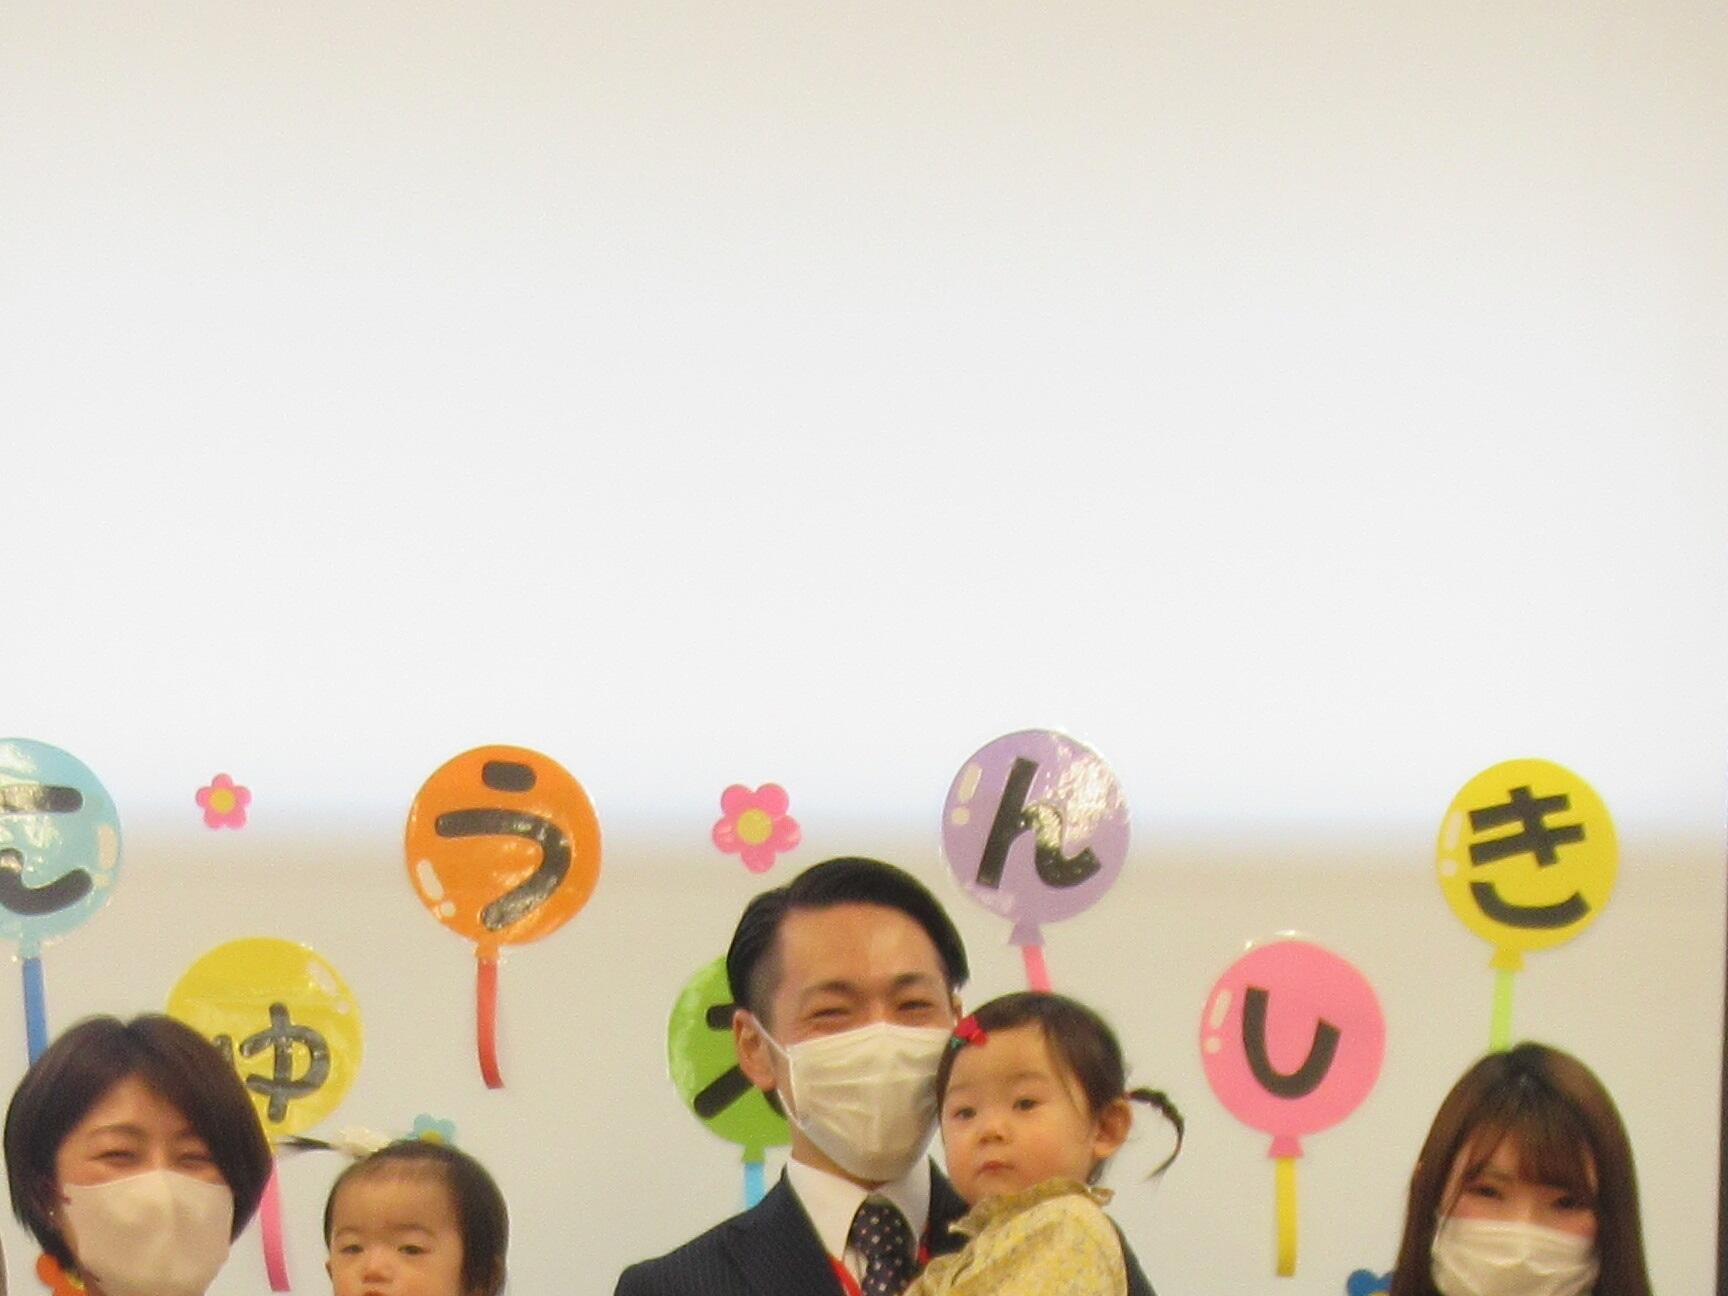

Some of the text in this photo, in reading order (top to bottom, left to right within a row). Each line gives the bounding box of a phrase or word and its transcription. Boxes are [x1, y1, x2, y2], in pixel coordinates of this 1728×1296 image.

[434, 760, 572, 931] う
[975, 755, 1102, 890] ん
[1241, 985, 1341, 1100] し
[1468, 784, 1592, 930] き
